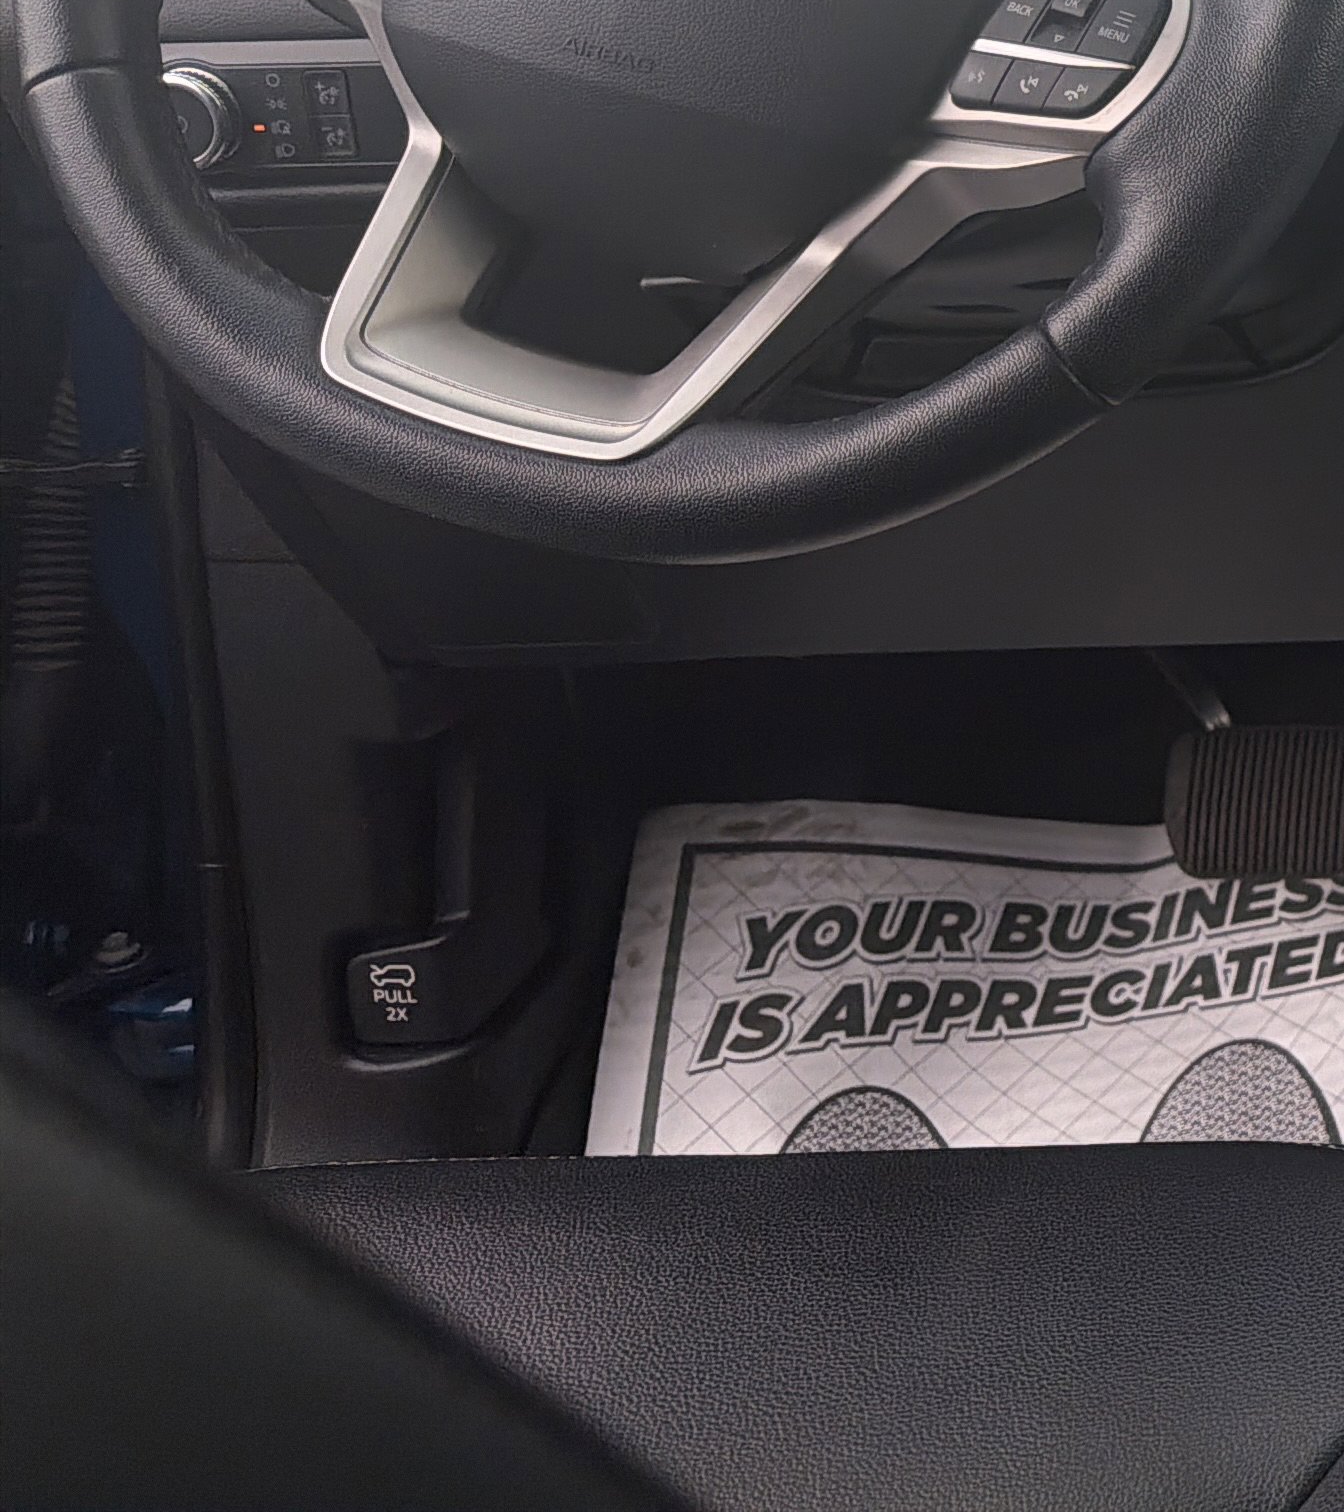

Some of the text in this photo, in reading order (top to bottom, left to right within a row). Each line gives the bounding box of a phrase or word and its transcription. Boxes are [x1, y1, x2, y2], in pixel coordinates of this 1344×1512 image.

[1006, 1, 1033, 18] BACK
[1097, 25, 1130, 44] MENU
[744, 898, 978, 973] YOUR
[372, 988, 418, 1004] PULL
[385, 1006, 409, 1022] 2X
[696, 991, 795, 1064] IS
